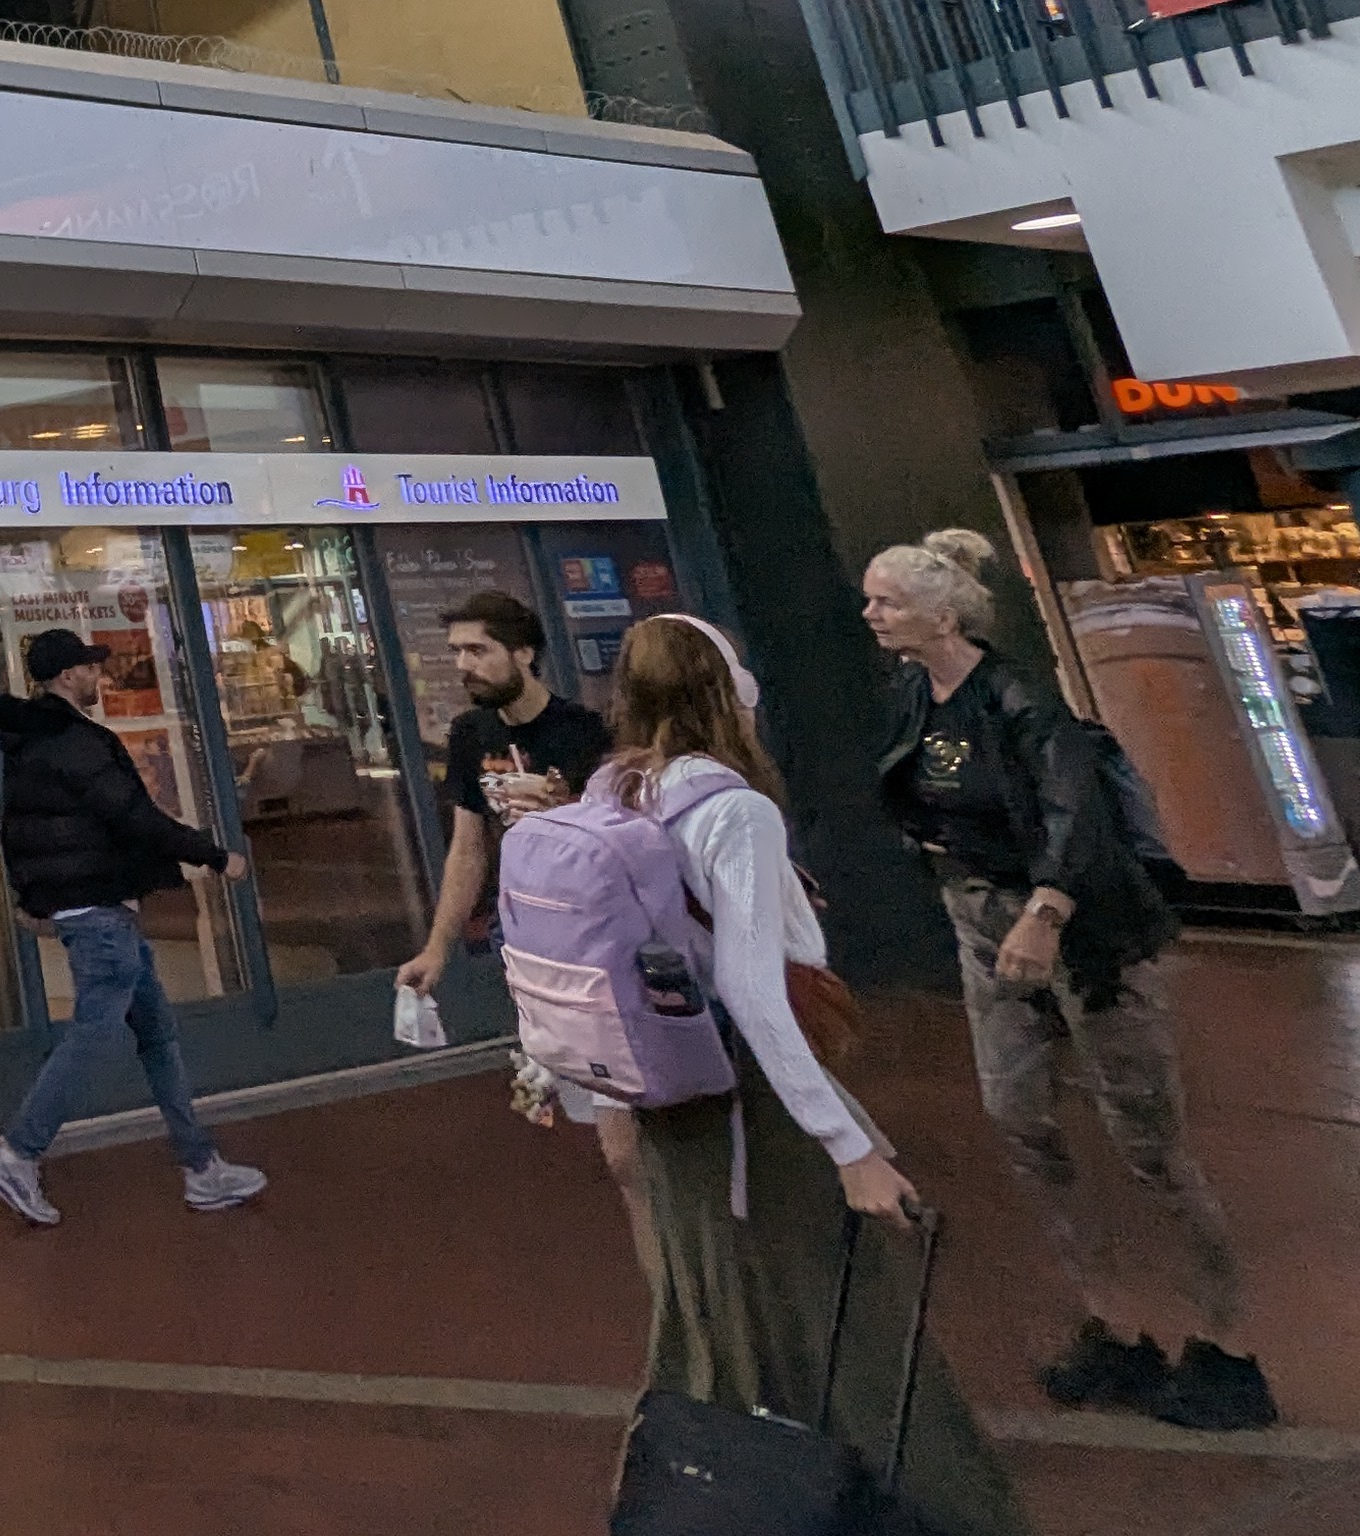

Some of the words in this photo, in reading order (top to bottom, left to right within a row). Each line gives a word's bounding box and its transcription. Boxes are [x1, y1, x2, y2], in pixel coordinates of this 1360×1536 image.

[58, 471, 235, 507] Information
[394, 473, 481, 505] Tourist
[484, 473, 621, 505] Information
[11, 592, 40, 606] LAST
[43, 590, 90, 605] MINUTE
